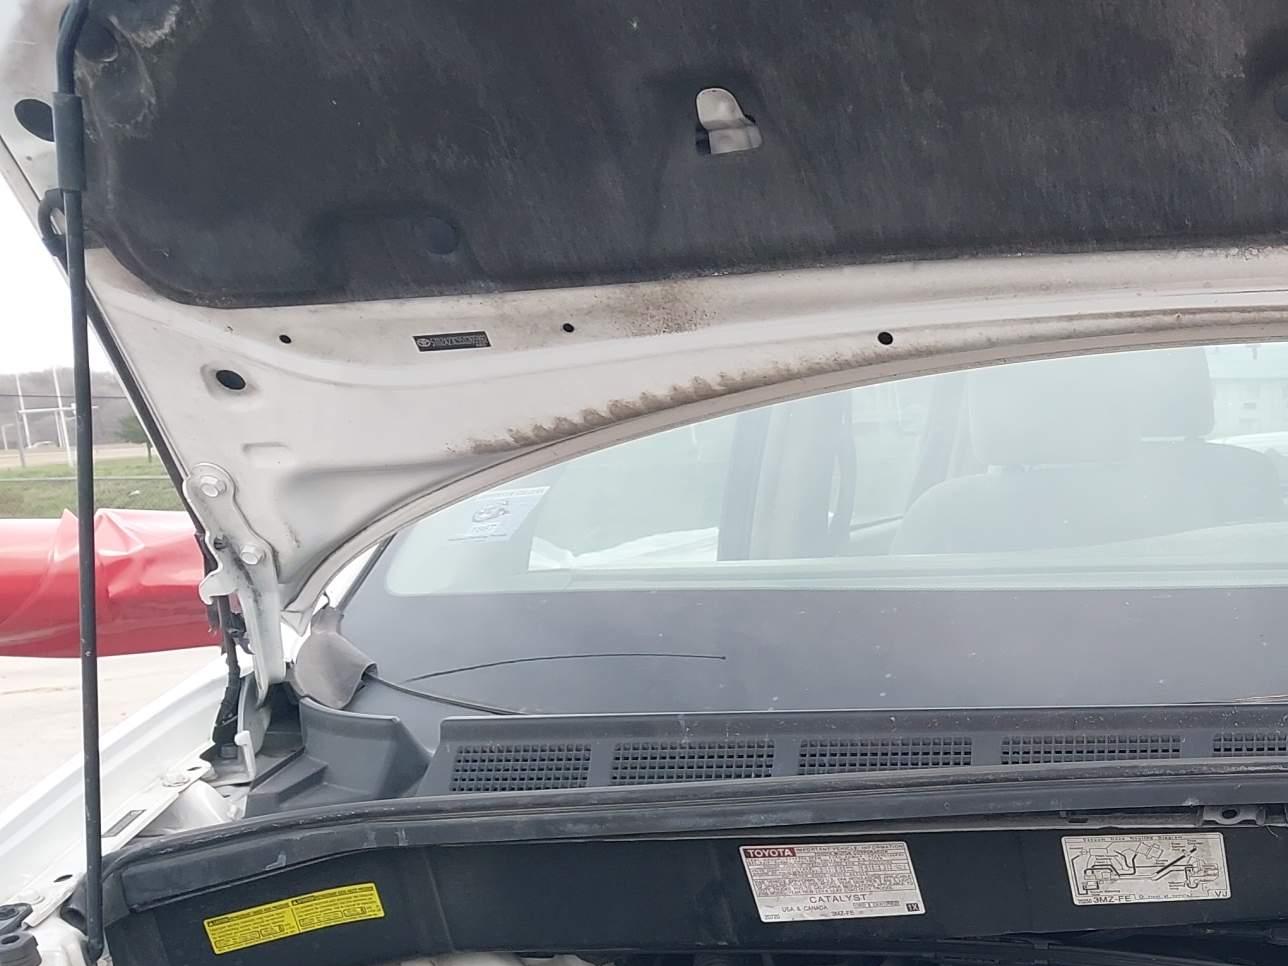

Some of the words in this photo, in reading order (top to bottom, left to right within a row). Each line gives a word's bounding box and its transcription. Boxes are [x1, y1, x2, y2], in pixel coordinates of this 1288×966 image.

[747, 849, 793, 858] TOYOTA
[1214, 890, 1228, 898] VJ
[809, 894, 868, 904] CATALYST
[1093, 896, 1133, 904] 3MZ-FE
